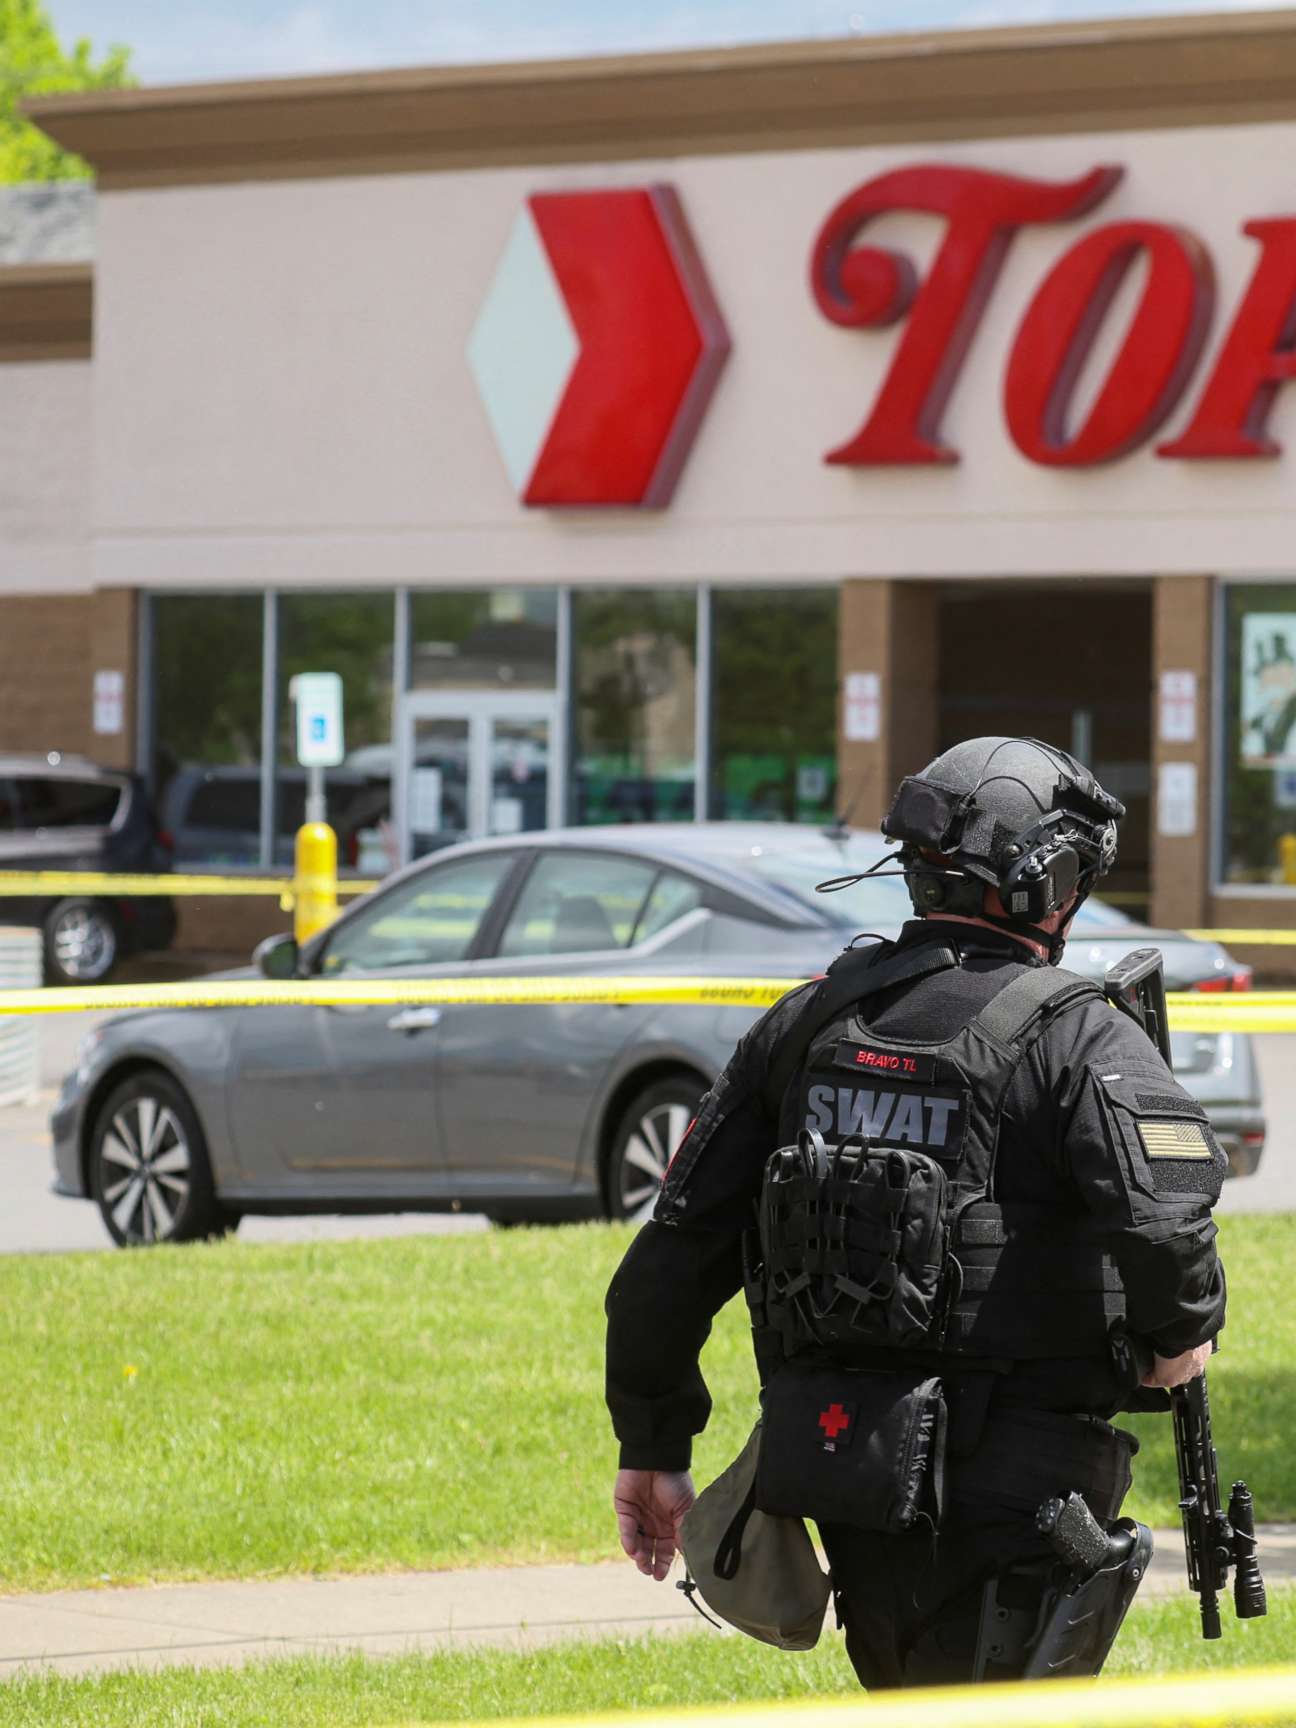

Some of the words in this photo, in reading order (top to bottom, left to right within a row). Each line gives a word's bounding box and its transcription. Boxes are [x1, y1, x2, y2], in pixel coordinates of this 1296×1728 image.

[856, 1050, 899, 1068] BRAVO
[902, 1058, 917, 1072] TL
[805, 1084, 960, 1147] SWAT
